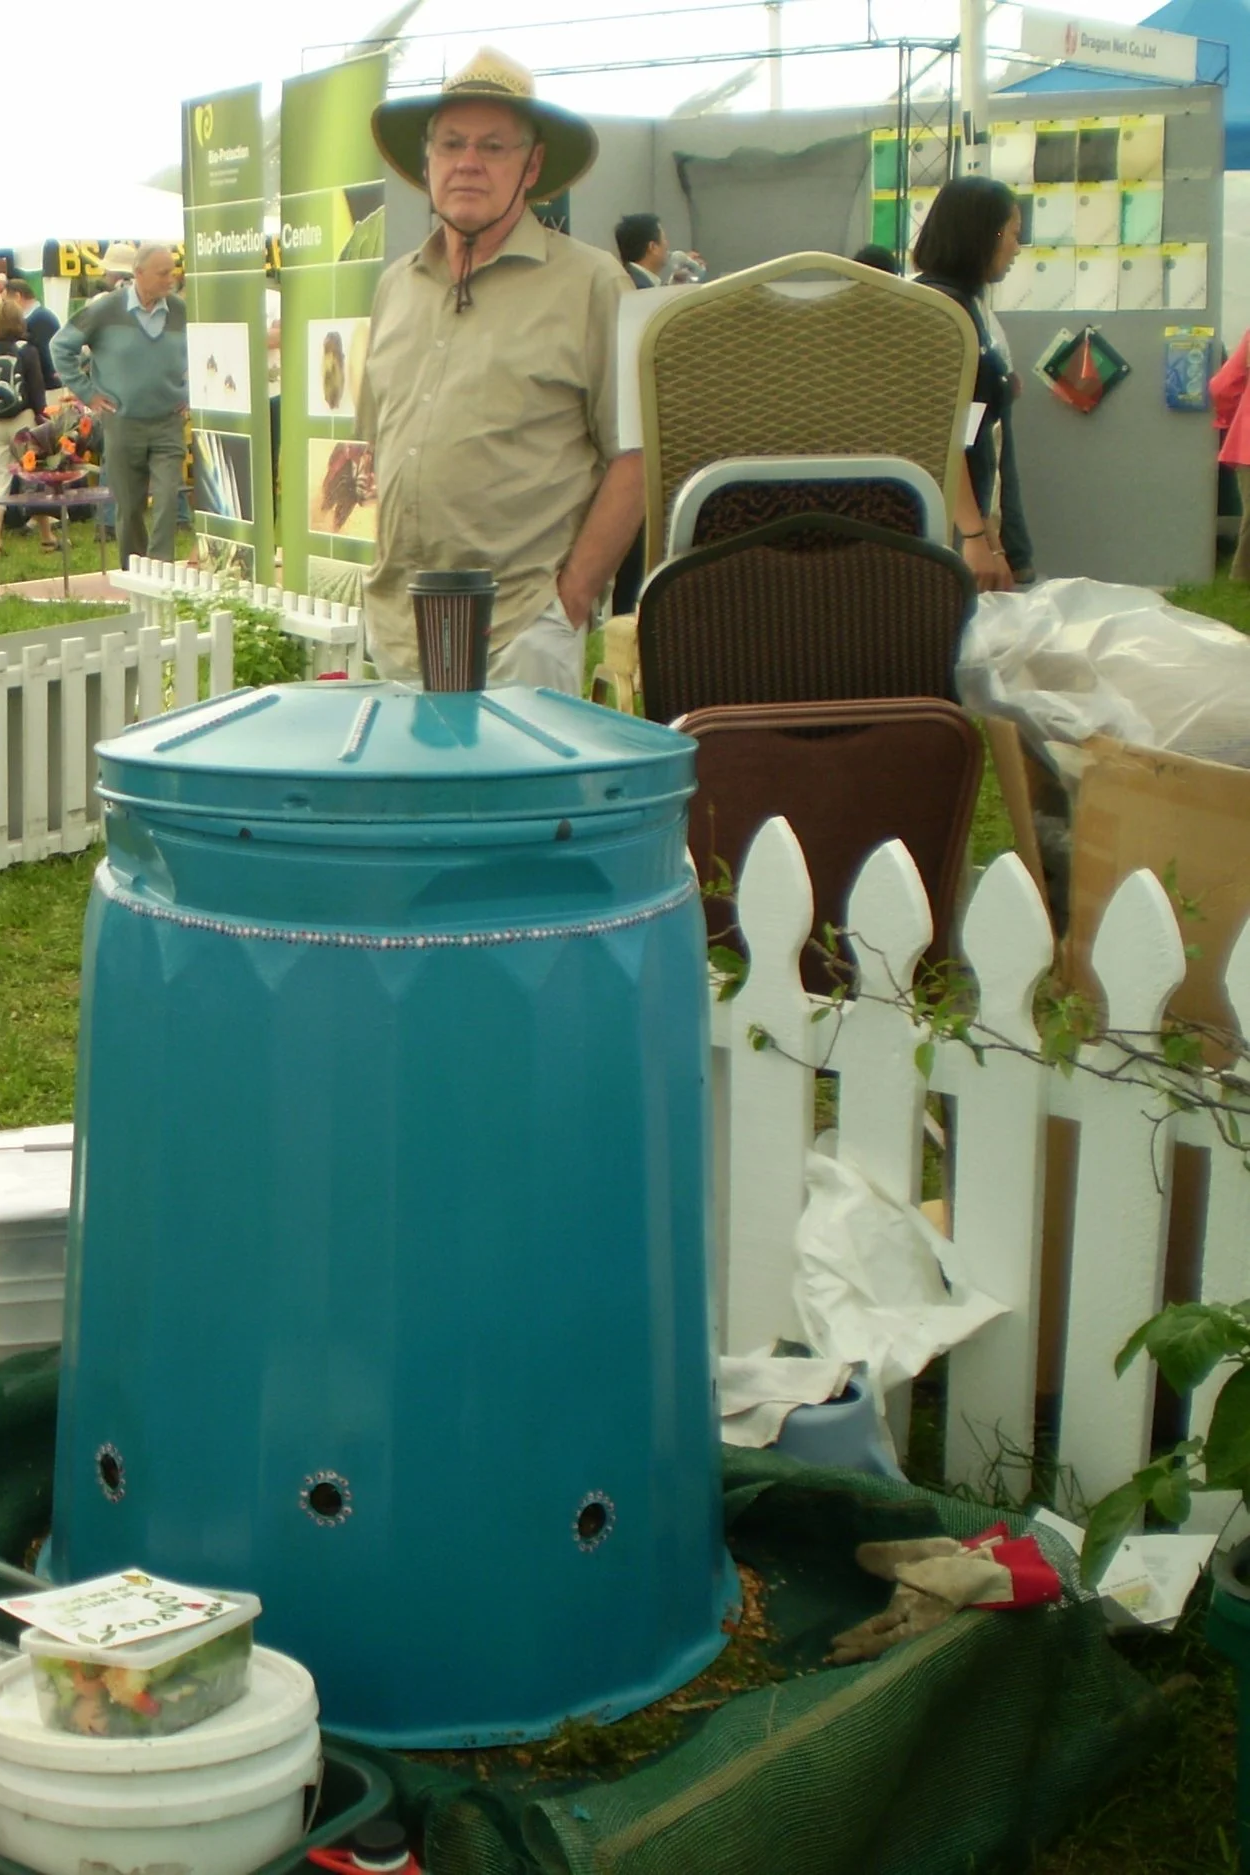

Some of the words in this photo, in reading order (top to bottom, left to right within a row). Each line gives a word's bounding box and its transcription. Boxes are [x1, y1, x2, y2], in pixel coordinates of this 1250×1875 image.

[1080, 31, 1110, 53] Dragon
[1112, 37, 1127, 54] Net
[196, 228, 266, 256] Bio-Protection
[282, 223, 322, 248] Centre
